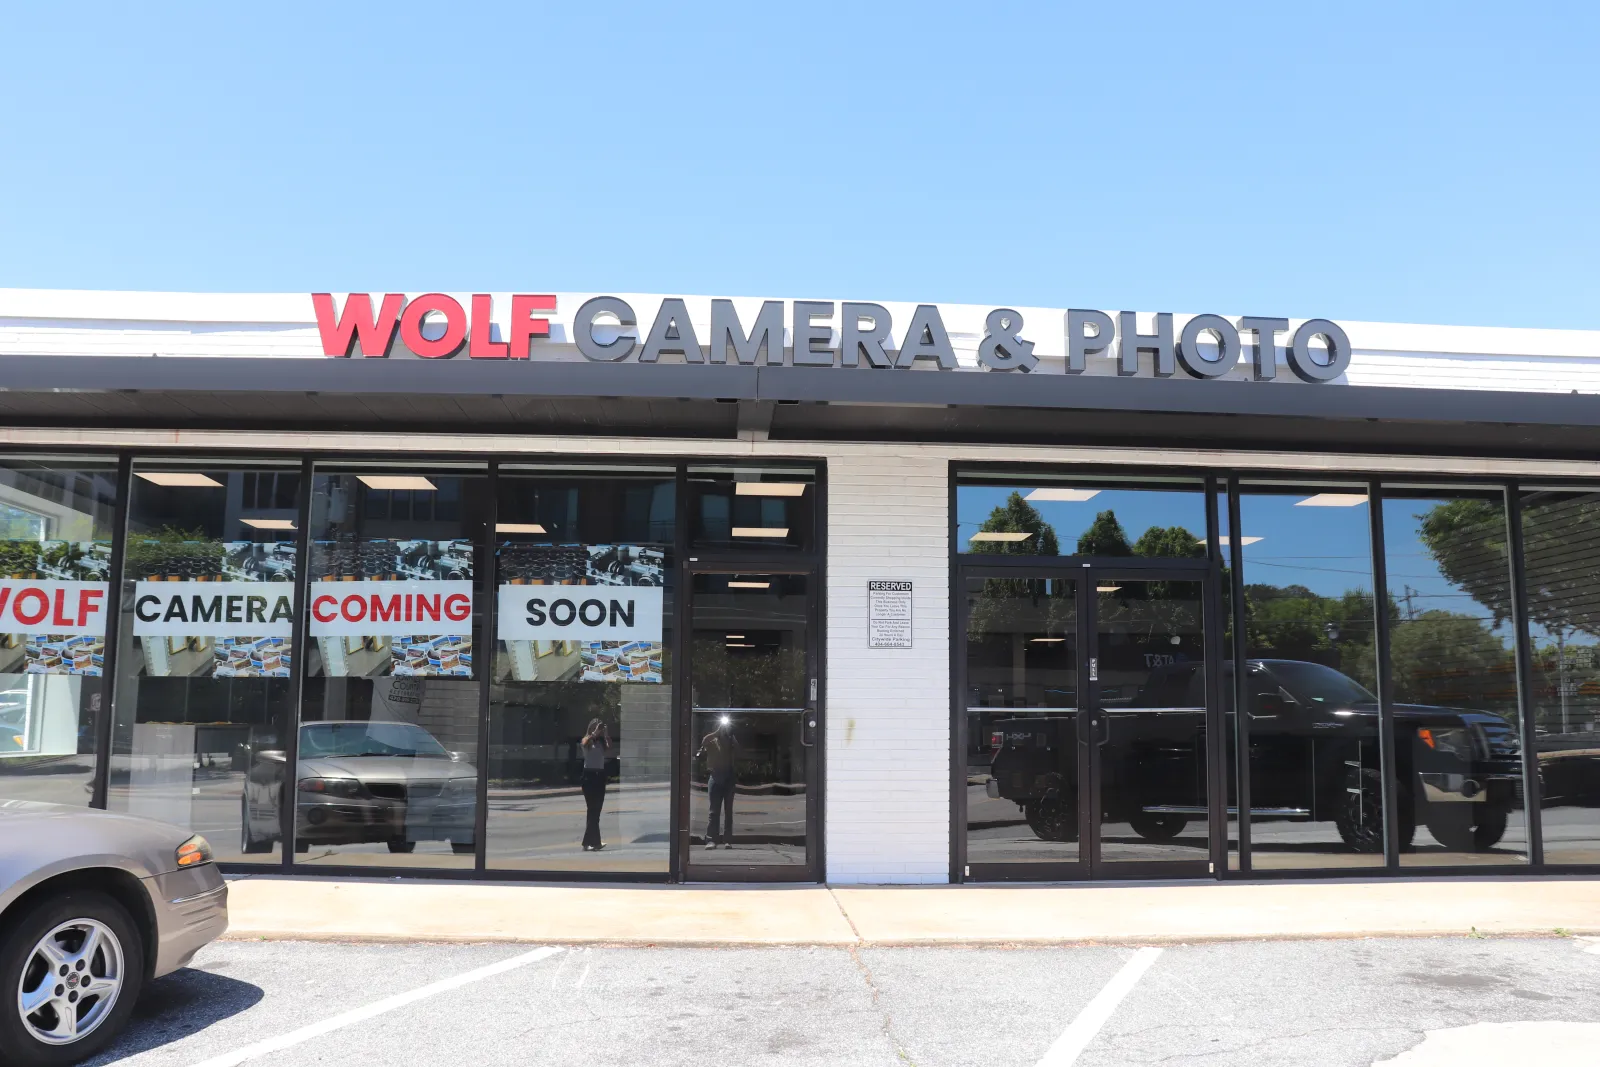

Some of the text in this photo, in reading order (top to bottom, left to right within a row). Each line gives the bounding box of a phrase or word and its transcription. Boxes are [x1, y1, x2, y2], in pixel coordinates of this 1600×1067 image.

[311, 293, 1351, 383] WOLF CAMERA & PHOTO
[871, 582, 911, 590] RESERVED
[0, 587, 103, 627] OLF
[135, 595, 293, 623] CAMERA
[312, 593, 471, 622] COMING
[526, 598, 635, 627] SOON
